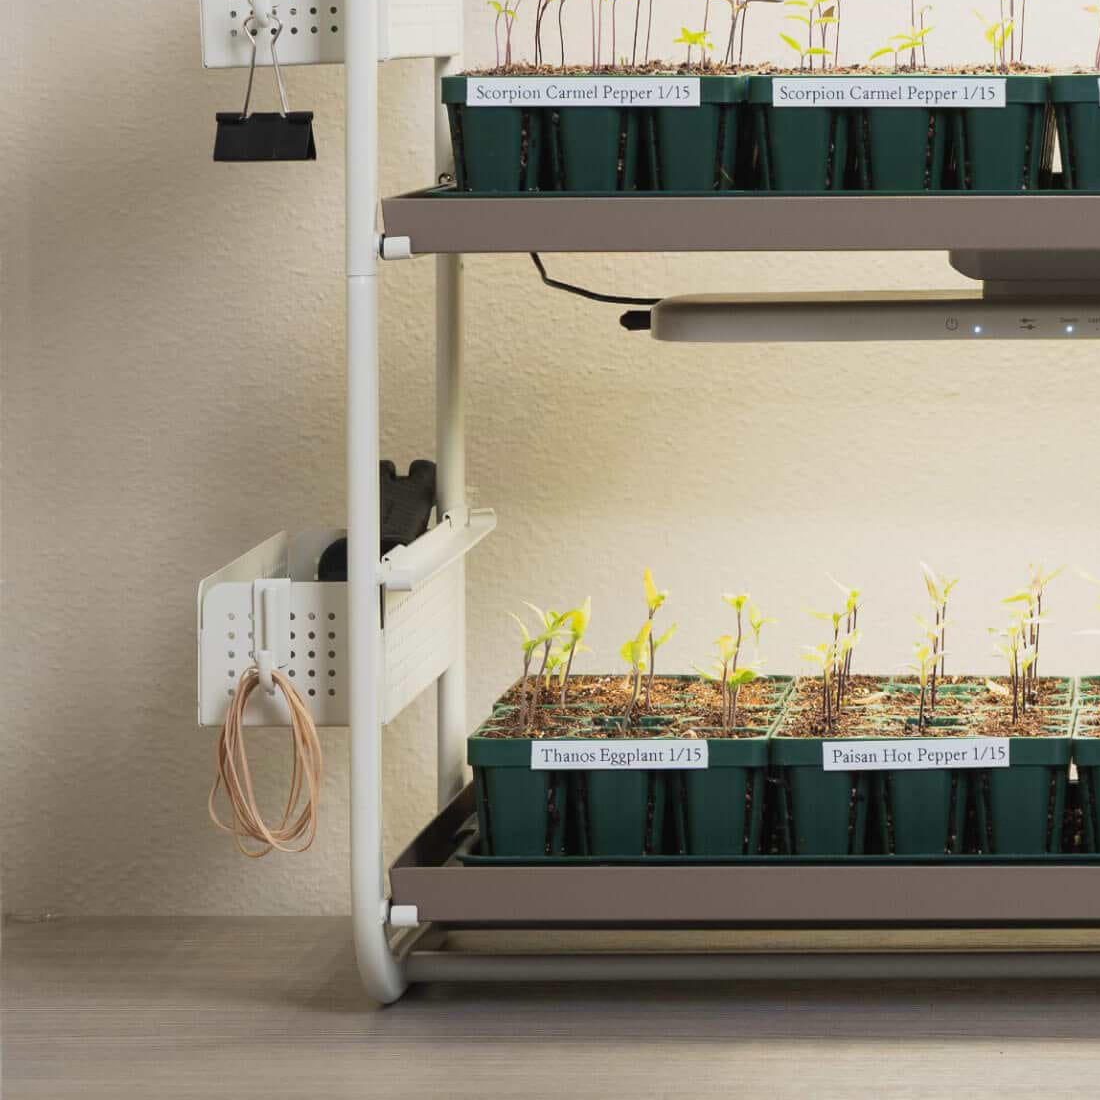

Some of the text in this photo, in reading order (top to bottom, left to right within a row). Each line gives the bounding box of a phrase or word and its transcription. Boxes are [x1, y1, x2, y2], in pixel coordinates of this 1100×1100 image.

[477, 85, 690, 103] Scorpion Carmel Pepper 1/15
[780, 85, 995, 104] Scorpion Carmel Pepper 1/15
[540, 747, 702, 766] Thanos Eggplant 1/15
[832, 746, 1005, 765] Paisan Hot Pepper 1/15
